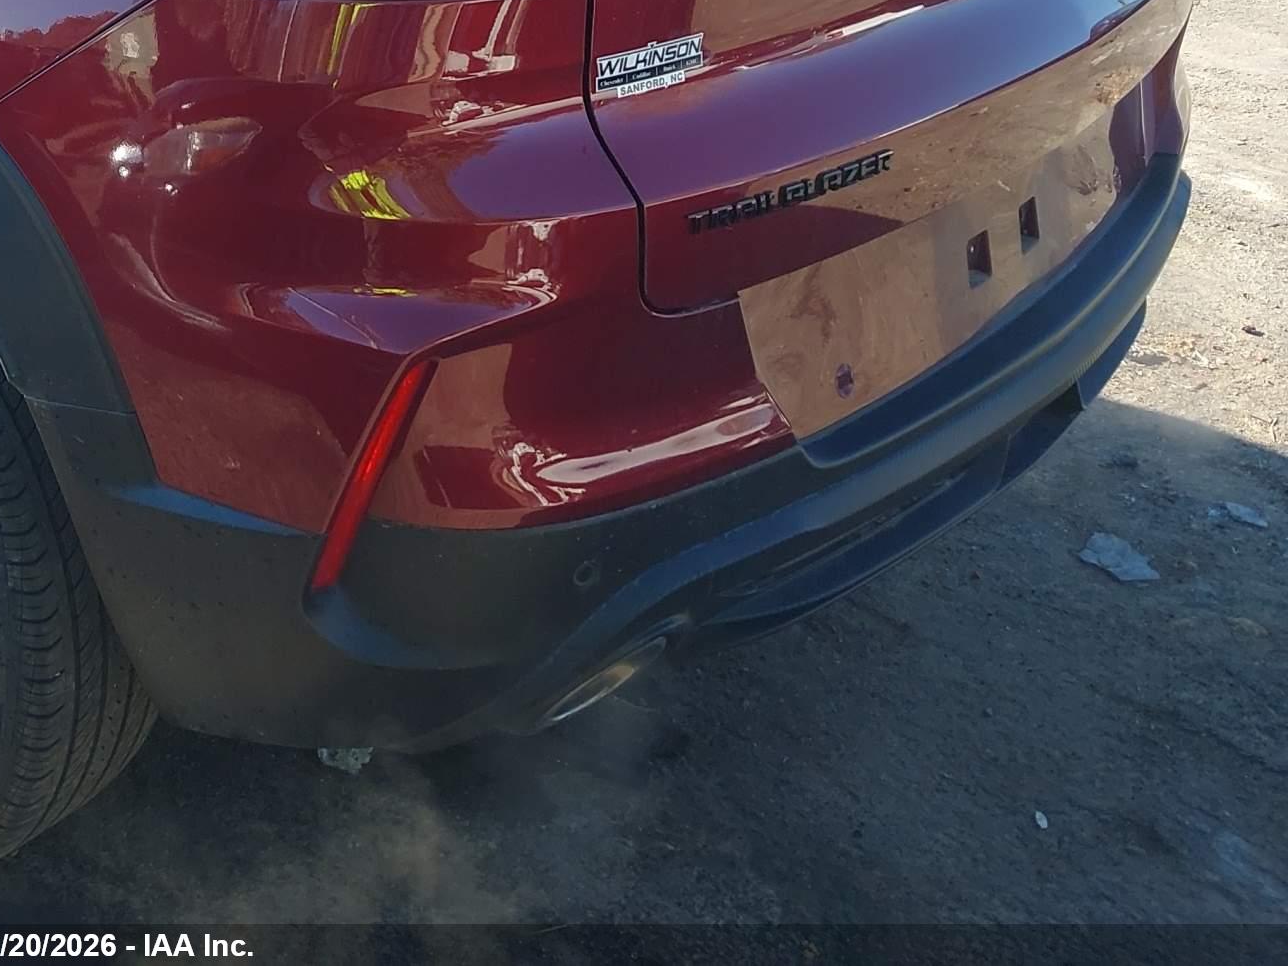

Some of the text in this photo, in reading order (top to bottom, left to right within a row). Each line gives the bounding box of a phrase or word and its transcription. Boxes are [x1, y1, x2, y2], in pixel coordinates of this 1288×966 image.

[599, 38, 702, 77] WILKINSON
[619, 72, 684, 96] SANFORD, NC
